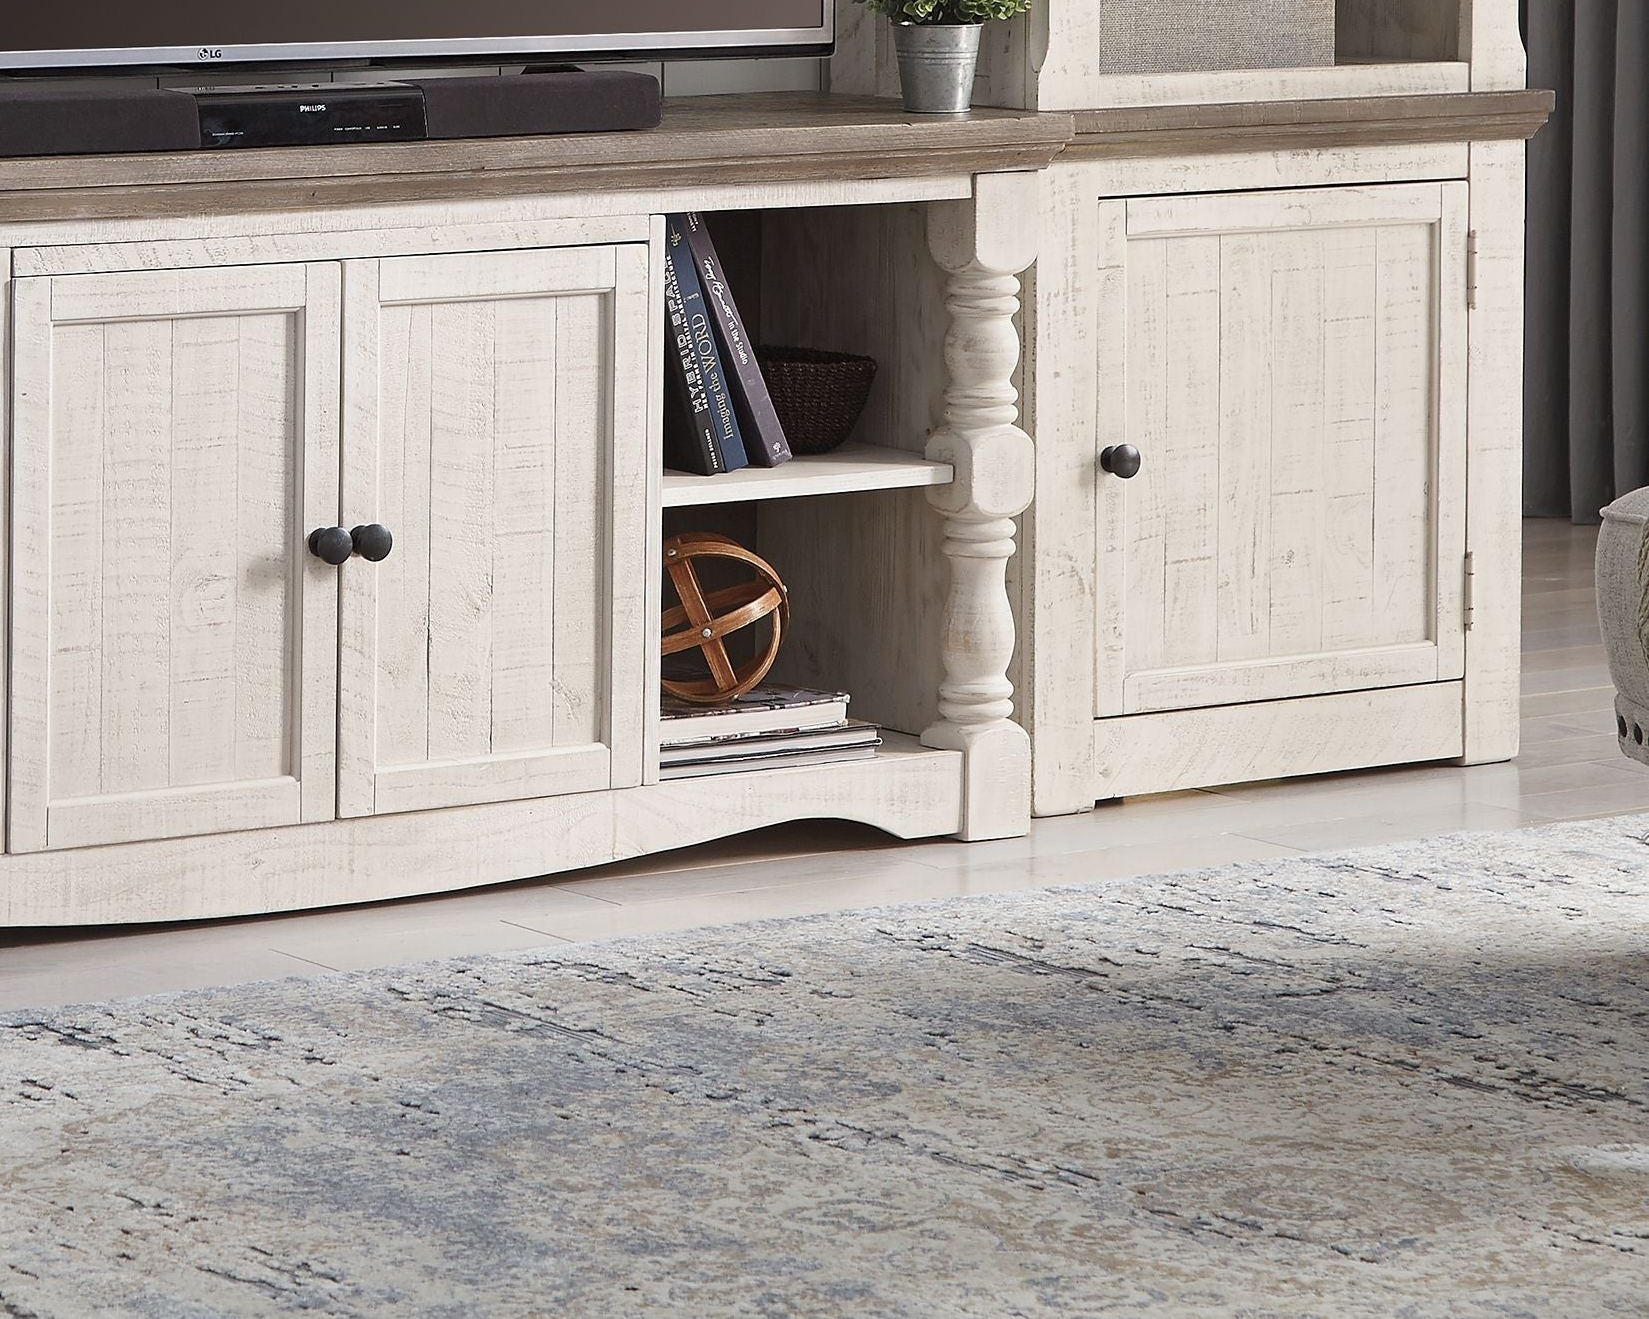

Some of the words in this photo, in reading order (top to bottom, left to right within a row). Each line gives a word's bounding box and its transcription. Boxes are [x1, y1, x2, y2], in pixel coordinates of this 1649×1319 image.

[299, 104, 327, 113] PHILIPS
[665, 261, 682, 326] SPAC
[692, 314, 717, 374] WORD
[736, 342, 749, 365] Studio
[677, 334, 703, 413] HYBRID
[709, 371, 721, 392] the
[701, 393, 709, 409] NEW
[716, 392, 734, 440] Imaging
